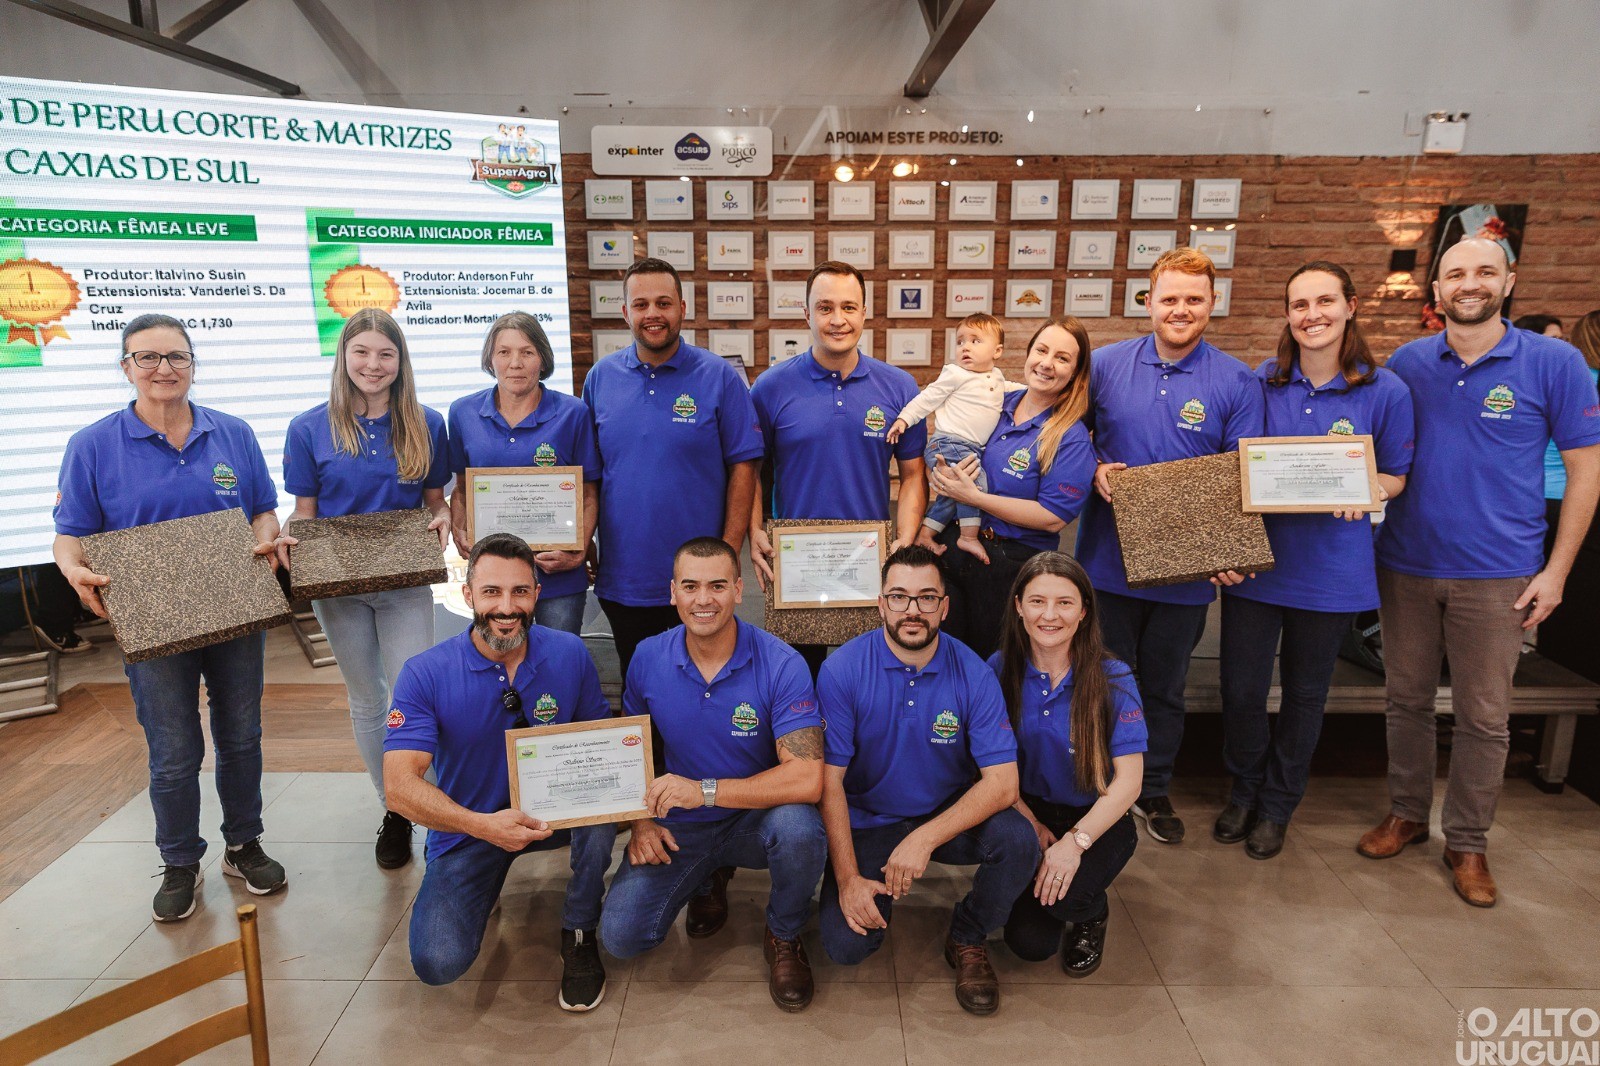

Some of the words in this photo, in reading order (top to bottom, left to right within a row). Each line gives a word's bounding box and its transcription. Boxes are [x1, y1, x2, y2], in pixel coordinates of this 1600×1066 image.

[9, 98, 65, 127] DE
[68, 103, 169, 134] PERU
[173, 110, 280, 141] CORTE
[285, 118, 310, 142] &
[313, 119, 453, 151] MATRIZES
[825, 131, 883, 144] APOIAM
[887, 131, 925, 144] ESTE
[928, 131, 1003, 144] PROJETO:
[722, 147, 757, 157] PORCO
[5, 149, 138, 179] CAXIAS
[142, 156, 192, 182] DE
[196, 158, 260, 184] SUL
[482, 165, 547, 180] SuperAgro
[0, 216, 113, 234] CATEGORIA
[117, 217, 183, 236] FÊMEA
[186, 221, 230, 237] LEVE
[328, 224, 415, 239] CATEGORIA
[419, 226, 493, 240] INICIADOR
[497, 226, 544, 241] FÊMEA
[786, 246, 804, 254] imv
[84, 269, 152, 281] Produtor:
[155, 269, 205, 281] Italvino
[208, 269, 246, 281] Susin
[403, 271, 455, 281] Produtor:
[458, 271, 508, 281] Anderson
[510, 271, 534, 281] Fuhr
[20, 271, 41, 295] 1
[354, 275, 371, 296] 1
[86, 285, 186, 298] Extensionista:
[189, 285, 250, 296] Vanderlei
[253, 286, 266, 296] S.
[269, 286, 286, 296] Da
[404, 285, 480, 296] Extensionista:
[482, 285, 526, 295] Jocemar
[528, 286, 538, 295] B.
[541, 285, 553, 294] de
[89, 303, 123, 315] Cruz
[406, 301, 432, 311] Avila
[201, 318, 234, 330] 1,730
[407, 314, 461, 325] Indicador:
[464, 314, 498, 324] Mortali
